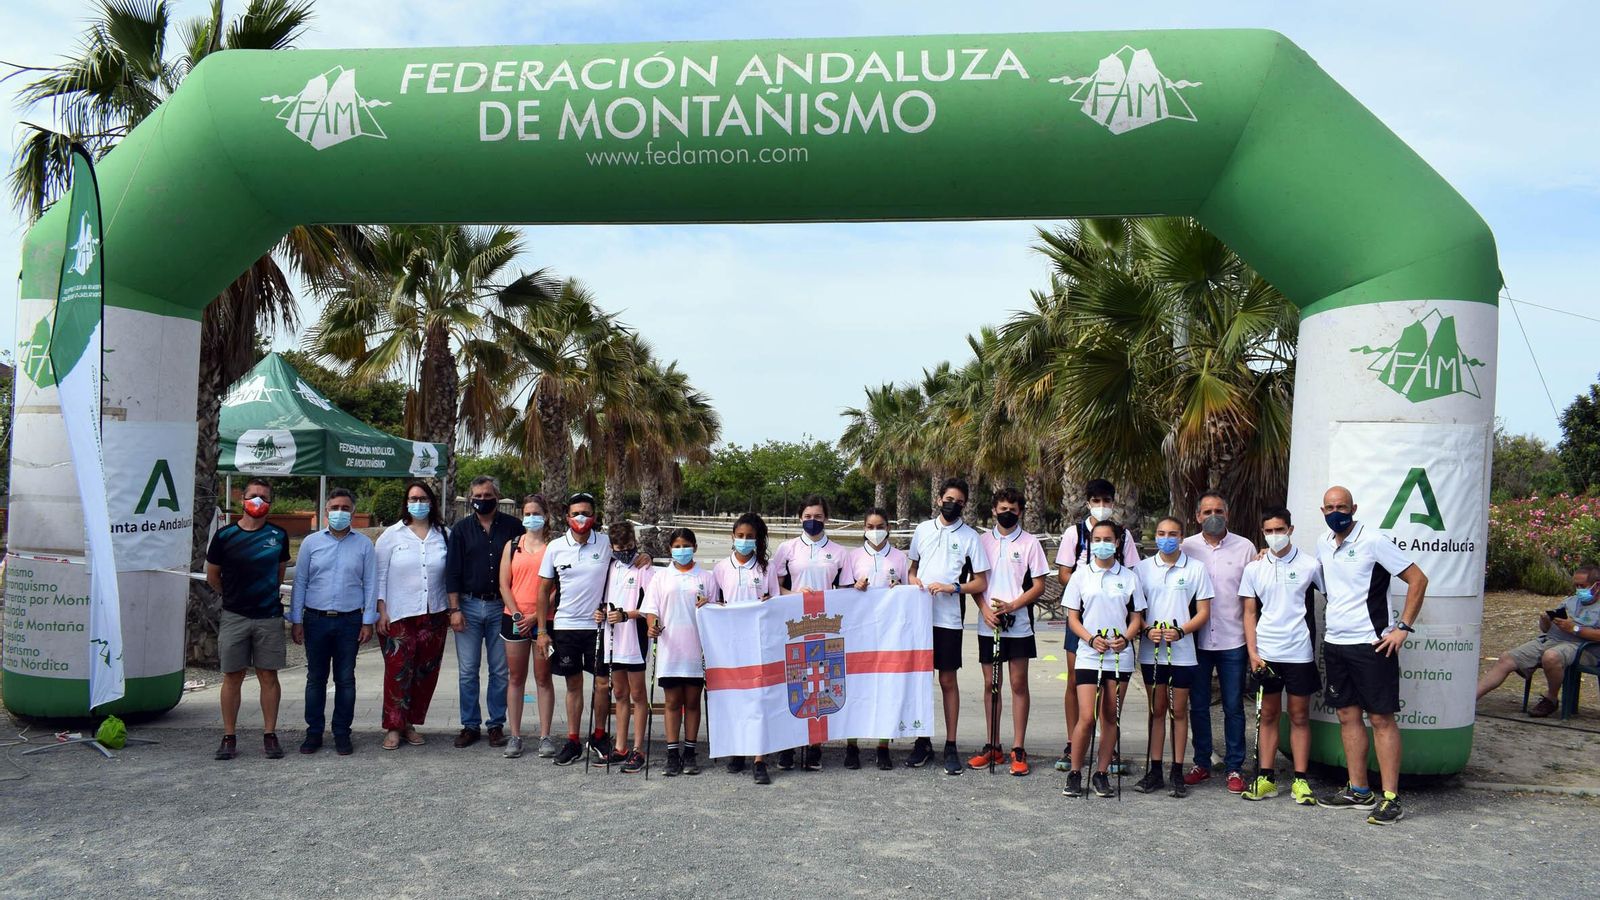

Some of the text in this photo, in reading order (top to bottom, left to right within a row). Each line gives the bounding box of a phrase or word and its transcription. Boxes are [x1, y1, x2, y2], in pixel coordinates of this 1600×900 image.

[400, 47, 1030, 94] FEDERACIÓN ANDALUZA
[479, 87, 937, 142] DE MONTAÑISMO
[586, 142, 809, 167] www.fedamon.com
[141, 519, 157, 532] de
[1411, 537, 1475, 553] Andalucía
[29, 595, 49, 607] por
[53, 593, 92, 606] Mont
[13, 617, 24, 629] de
[26, 620, 84, 632] Montaña
[1424, 638, 1474, 652] Montaña
[20, 658, 69, 671] Nórdica
[1399, 668, 1453, 681] ontaña
